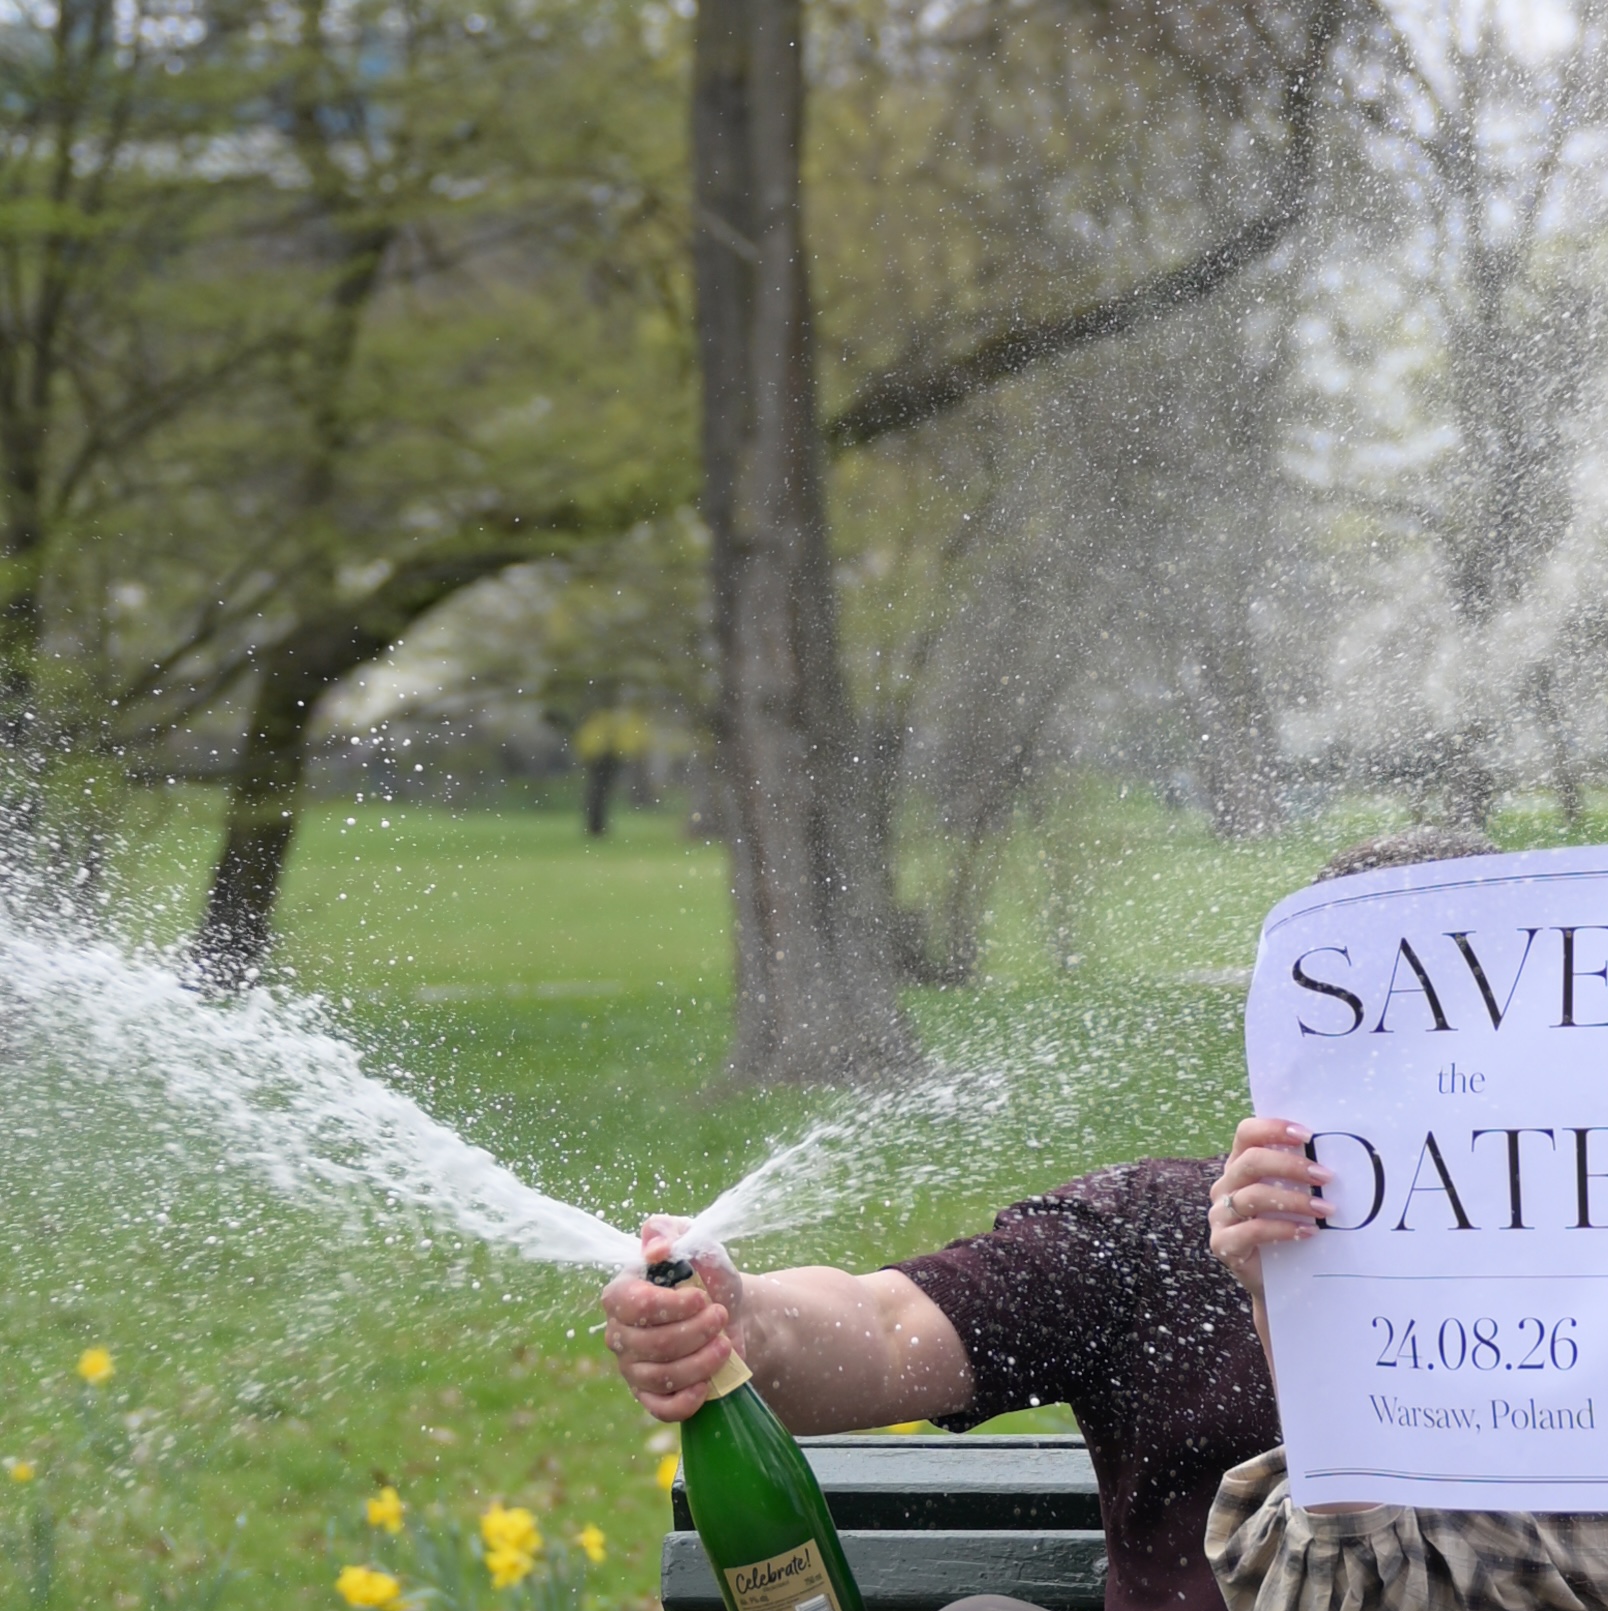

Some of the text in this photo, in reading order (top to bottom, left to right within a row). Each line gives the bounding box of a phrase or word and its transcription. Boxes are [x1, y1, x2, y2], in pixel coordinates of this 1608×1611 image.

[1437, 1062, 1486, 1095] the
[1371, 1315, 1579, 1371] 24.08.26
[1368, 1393, 1596, 1434] Warsaw, Poland
[735, 1548, 812, 1595] Celebrate!
